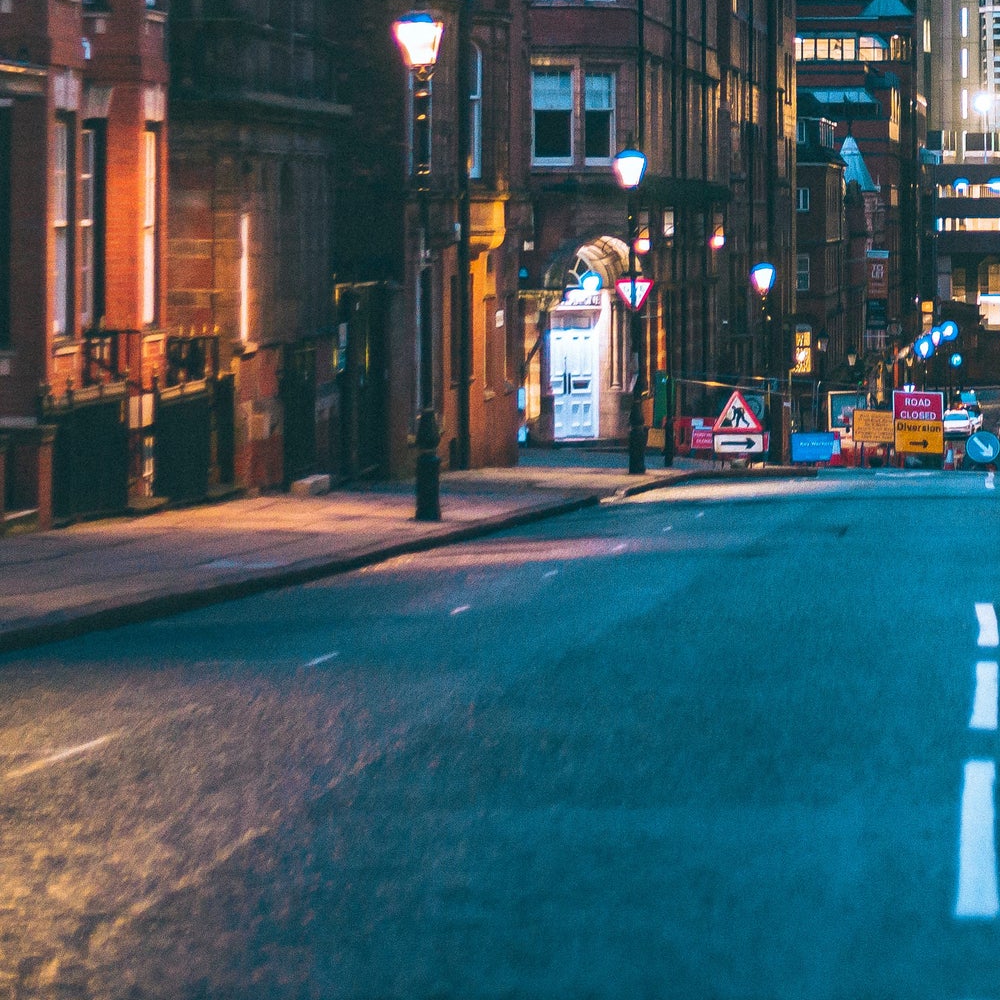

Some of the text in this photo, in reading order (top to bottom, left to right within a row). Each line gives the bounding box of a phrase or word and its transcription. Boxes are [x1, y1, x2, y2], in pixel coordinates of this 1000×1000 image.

[872, 263, 884, 271] TO
[905, 397, 931, 407] ROAD
[900, 410, 937, 420] CLOSED
[897, 422, 941, 432] Diversion
